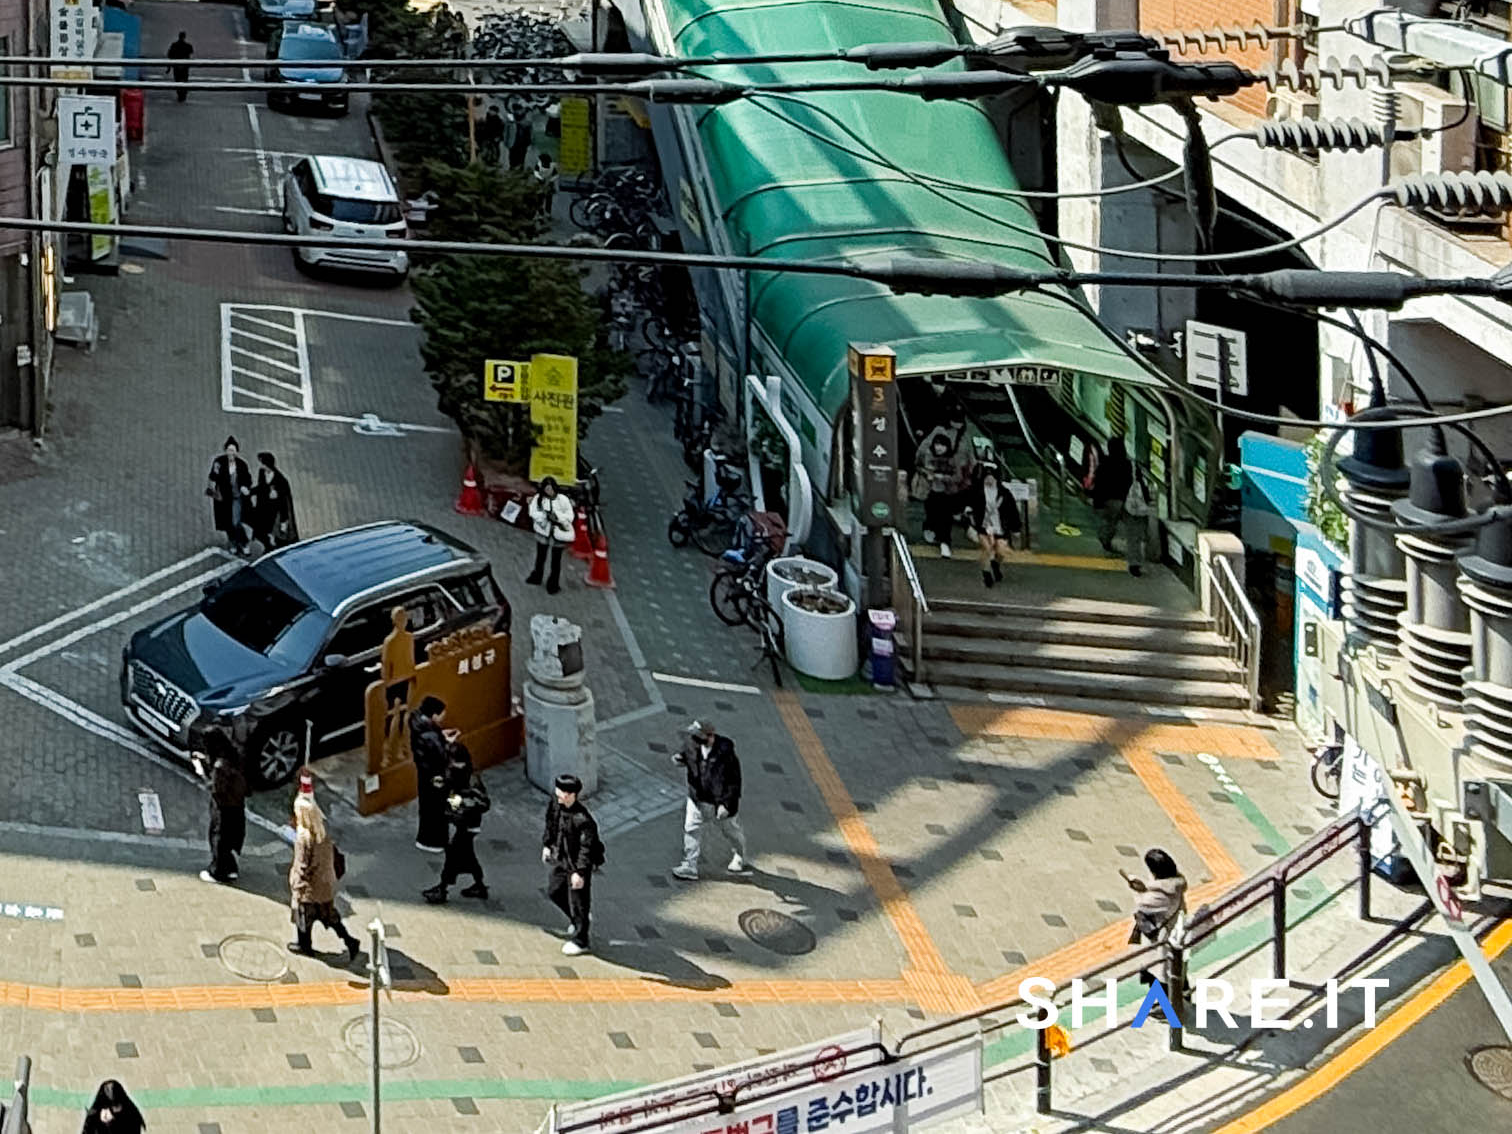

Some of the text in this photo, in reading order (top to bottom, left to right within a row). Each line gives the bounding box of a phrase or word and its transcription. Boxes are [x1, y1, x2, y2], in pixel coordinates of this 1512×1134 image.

[497, 366, 512, 382] P
[873, 387, 885, 402] 3
[806, 1066, 934, 1133] 준수합시다.
